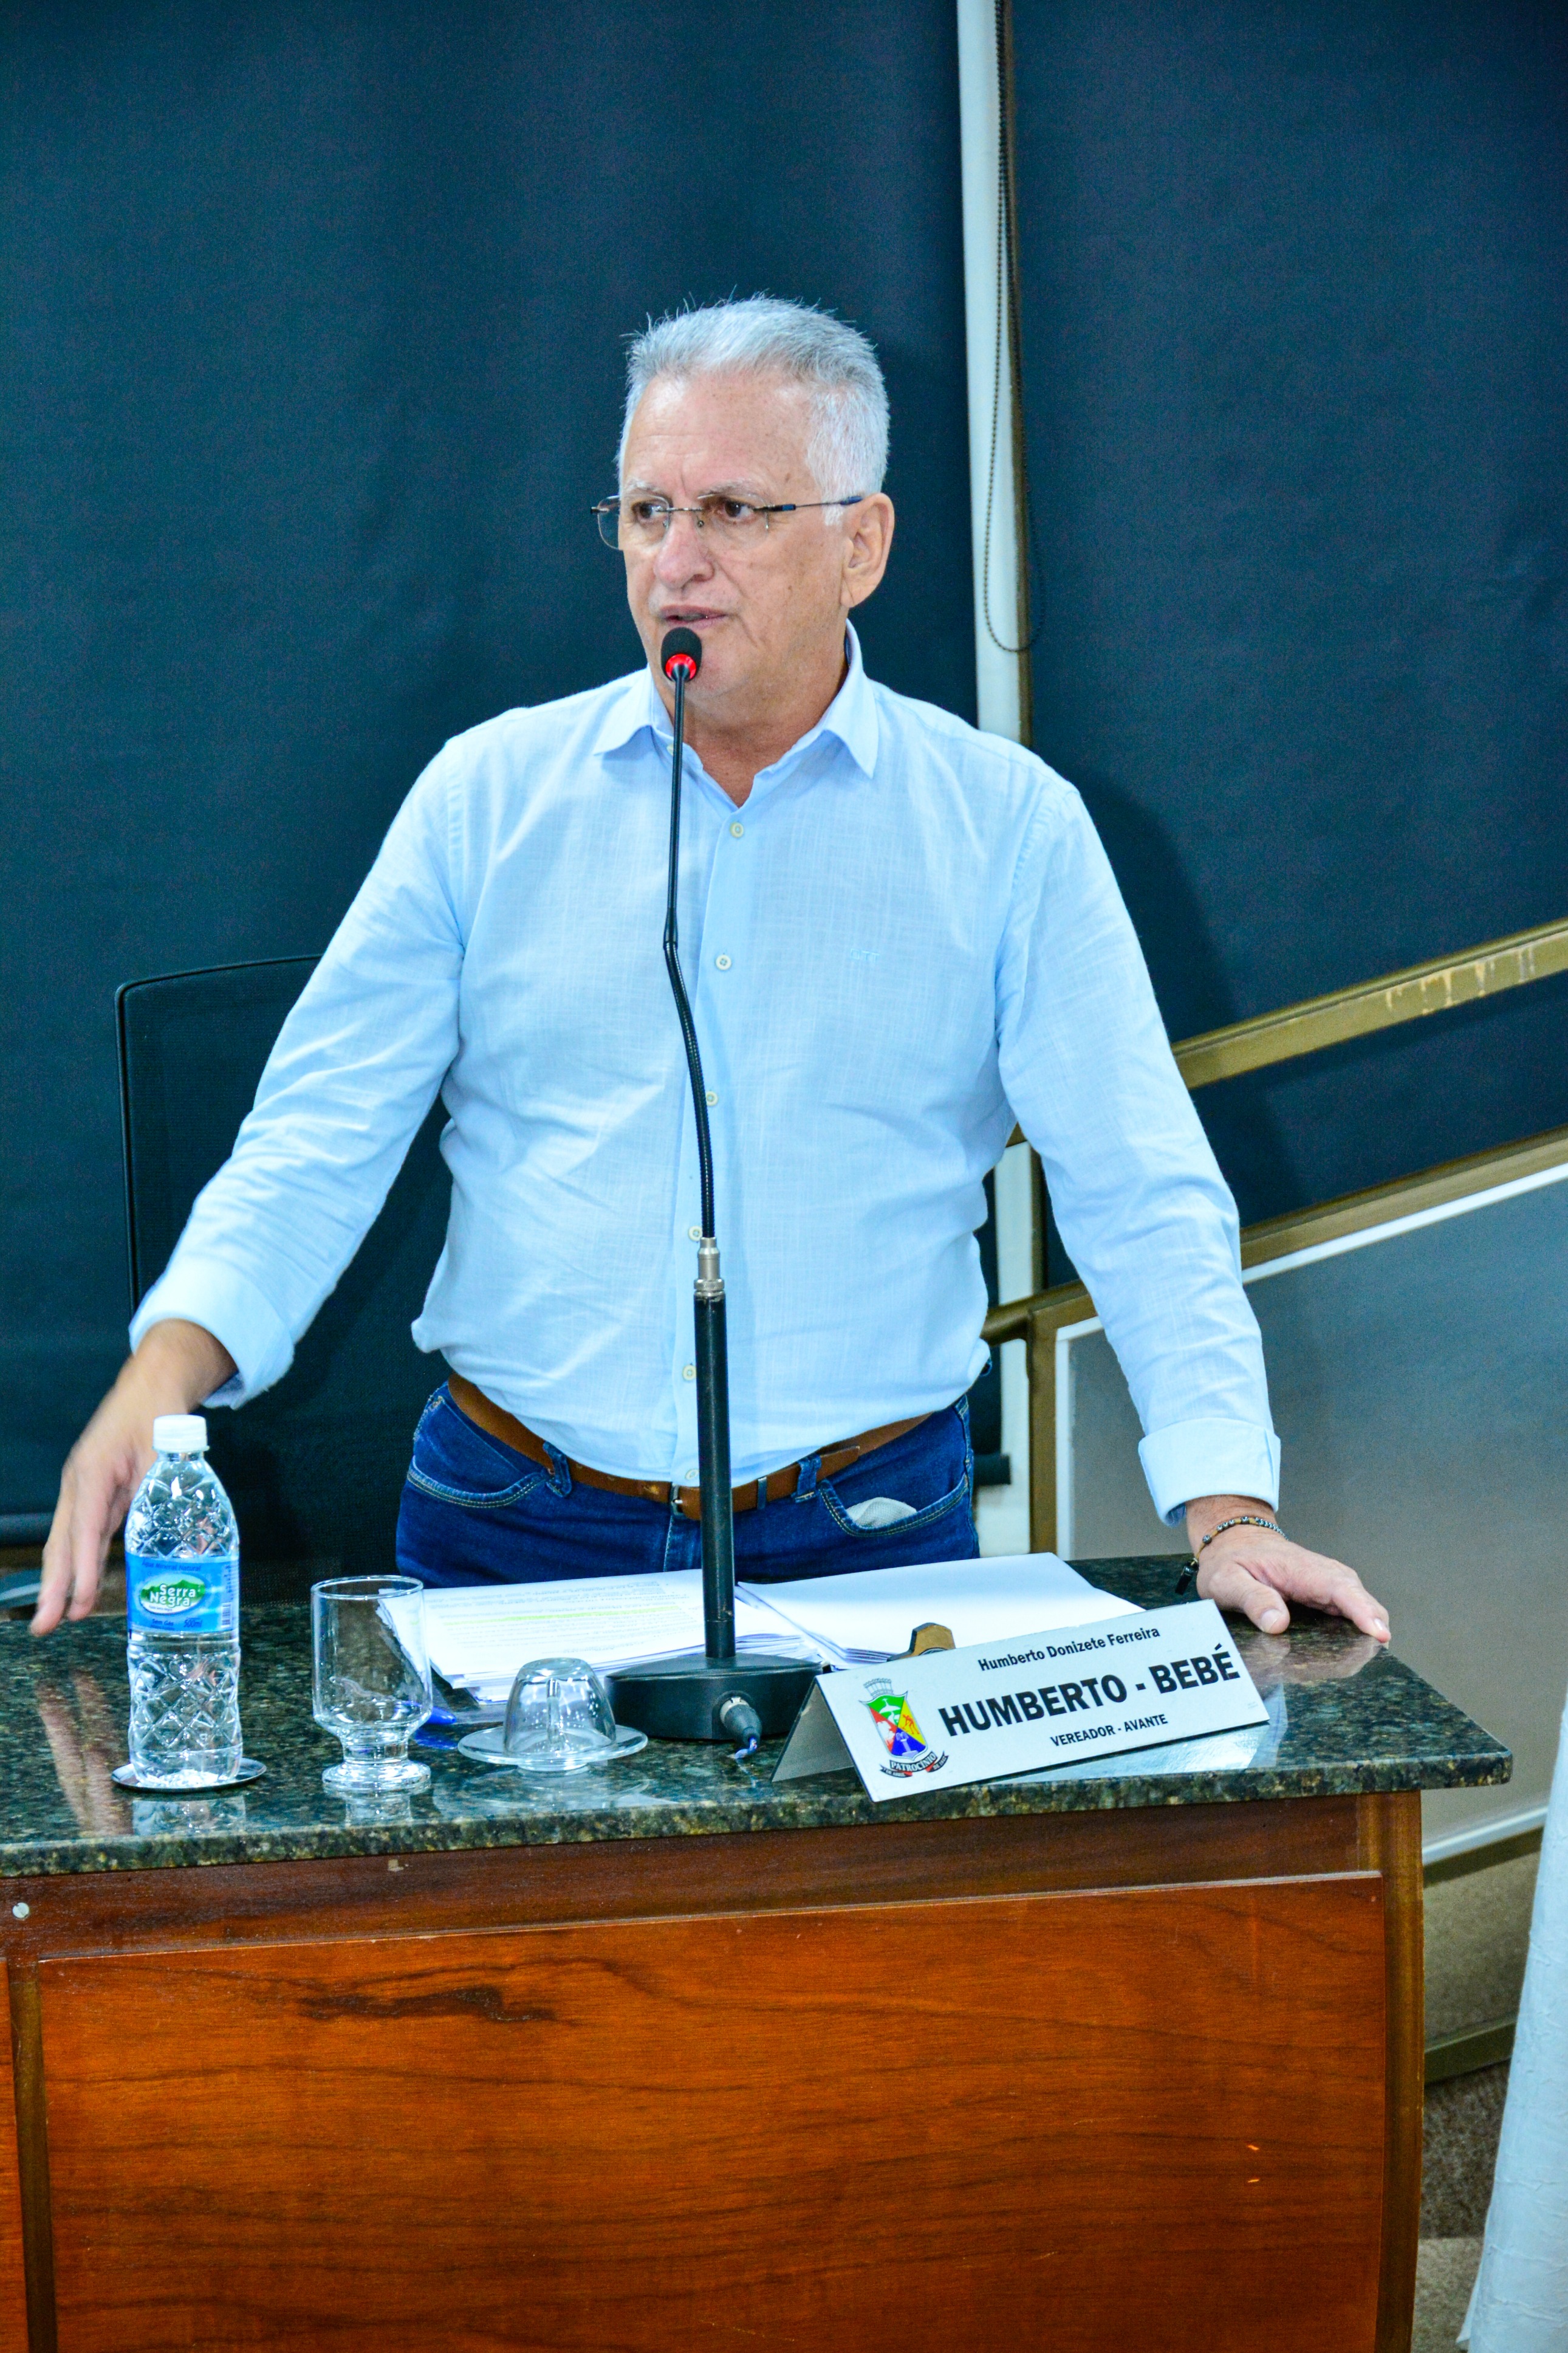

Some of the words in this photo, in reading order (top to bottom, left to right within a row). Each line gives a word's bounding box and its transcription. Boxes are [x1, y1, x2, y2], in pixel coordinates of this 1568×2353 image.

[149, 1592, 190, 1608] Negra
[159, 1583, 196, 1598] Serra
[183, 1619, 203, 1628] 500ml
[977, 1649, 1046, 1671] Humberto
[1046, 1637, 1106, 1658] Donizete
[1107, 1627, 1160, 1646] Ferreira
[938, 1674, 1128, 1737] HUMBERTO
[1135, 1682, 1147, 1691] -
[1149, 1643, 1241, 1694] BEBÉ
[1050, 1725, 1114, 1747] VEREADOR
[1125, 1714, 1169, 1733] AVANTE
[891, 1753, 937, 1772] PATROCÍNIO
